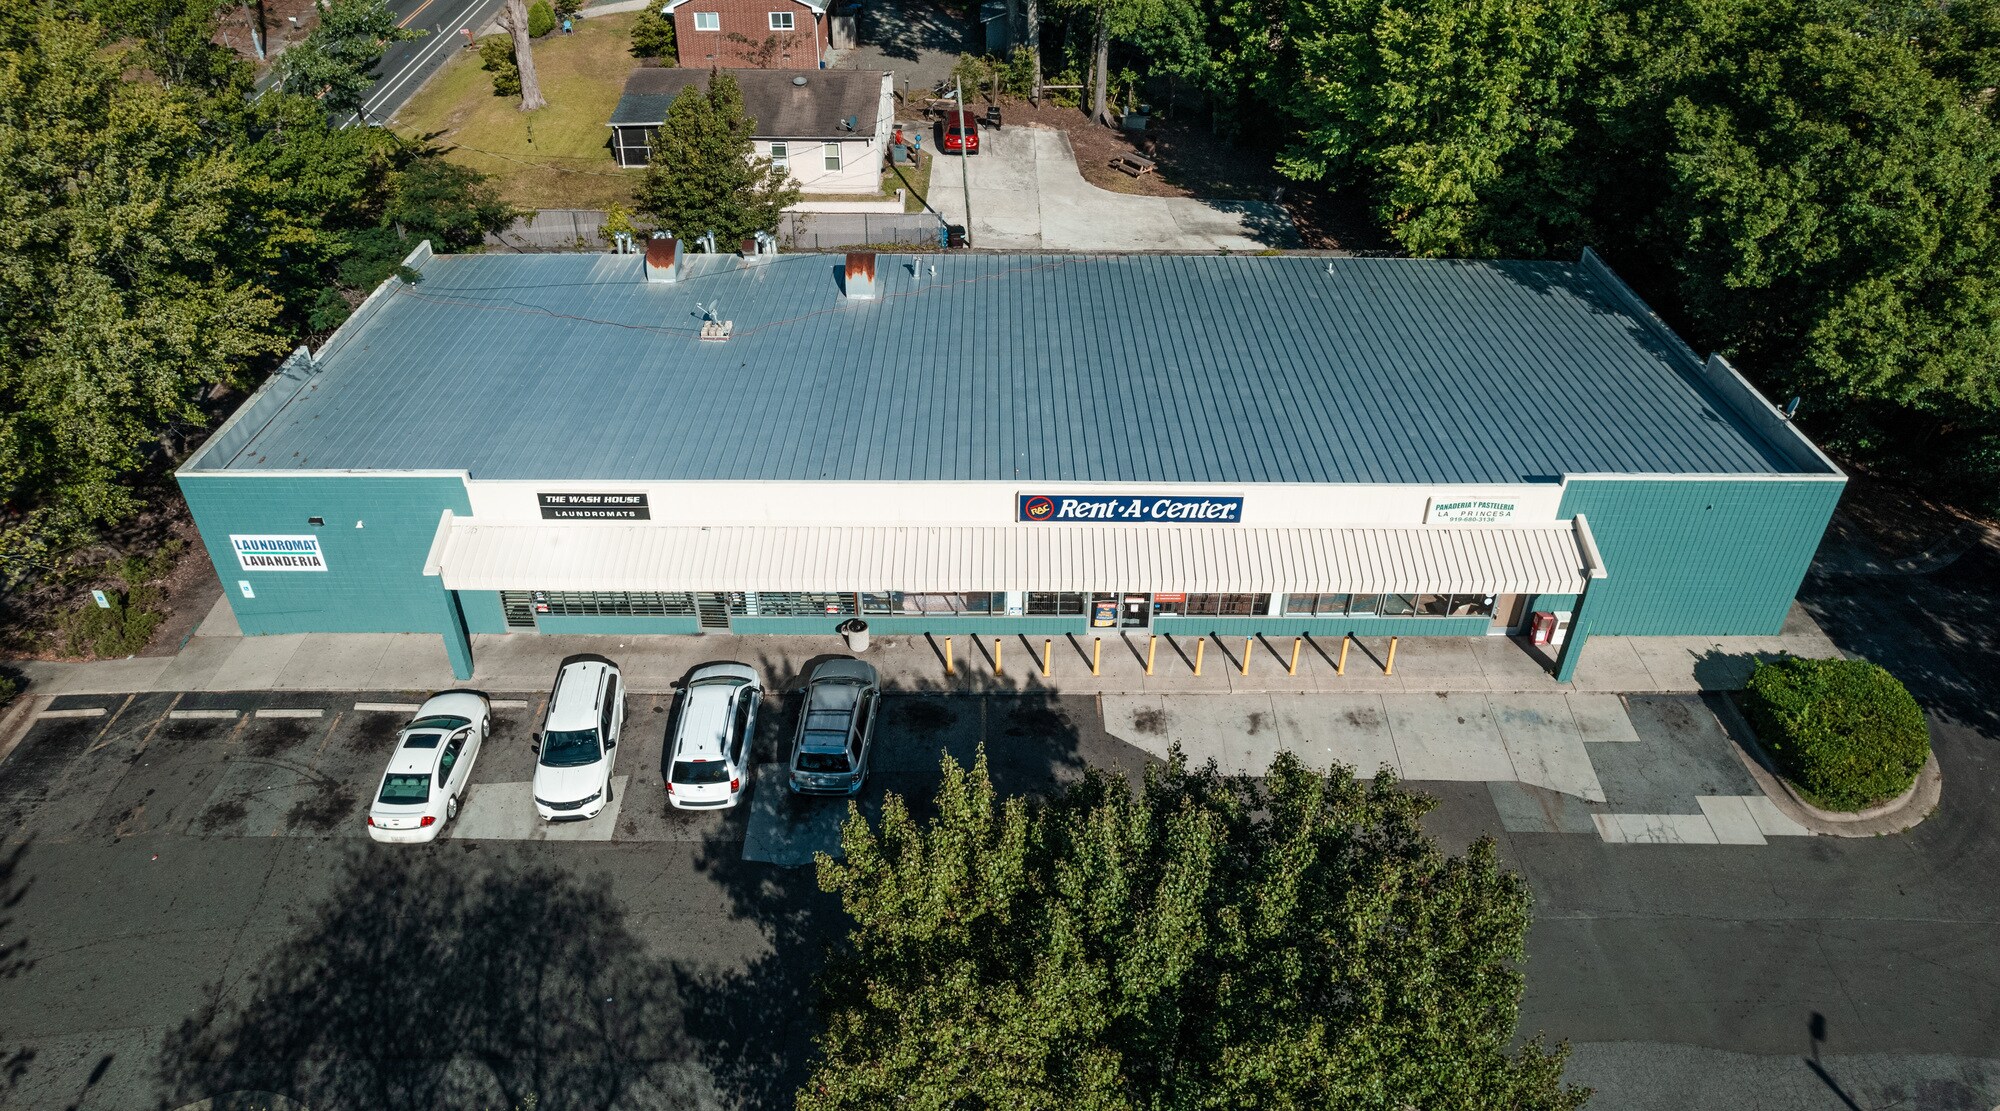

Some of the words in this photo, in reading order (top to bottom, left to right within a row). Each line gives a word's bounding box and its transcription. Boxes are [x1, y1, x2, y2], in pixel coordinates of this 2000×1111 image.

[569, 496, 601, 504] WASH
[604, 496, 640, 504] HOUSE
[1435, 502, 1472, 510] PANADERIA
[1478, 501, 1514, 510] PASTELERIA
[234, 540, 317, 550] LAUNDROMAT
[242, 556, 321, 566] LAVANDERIA
